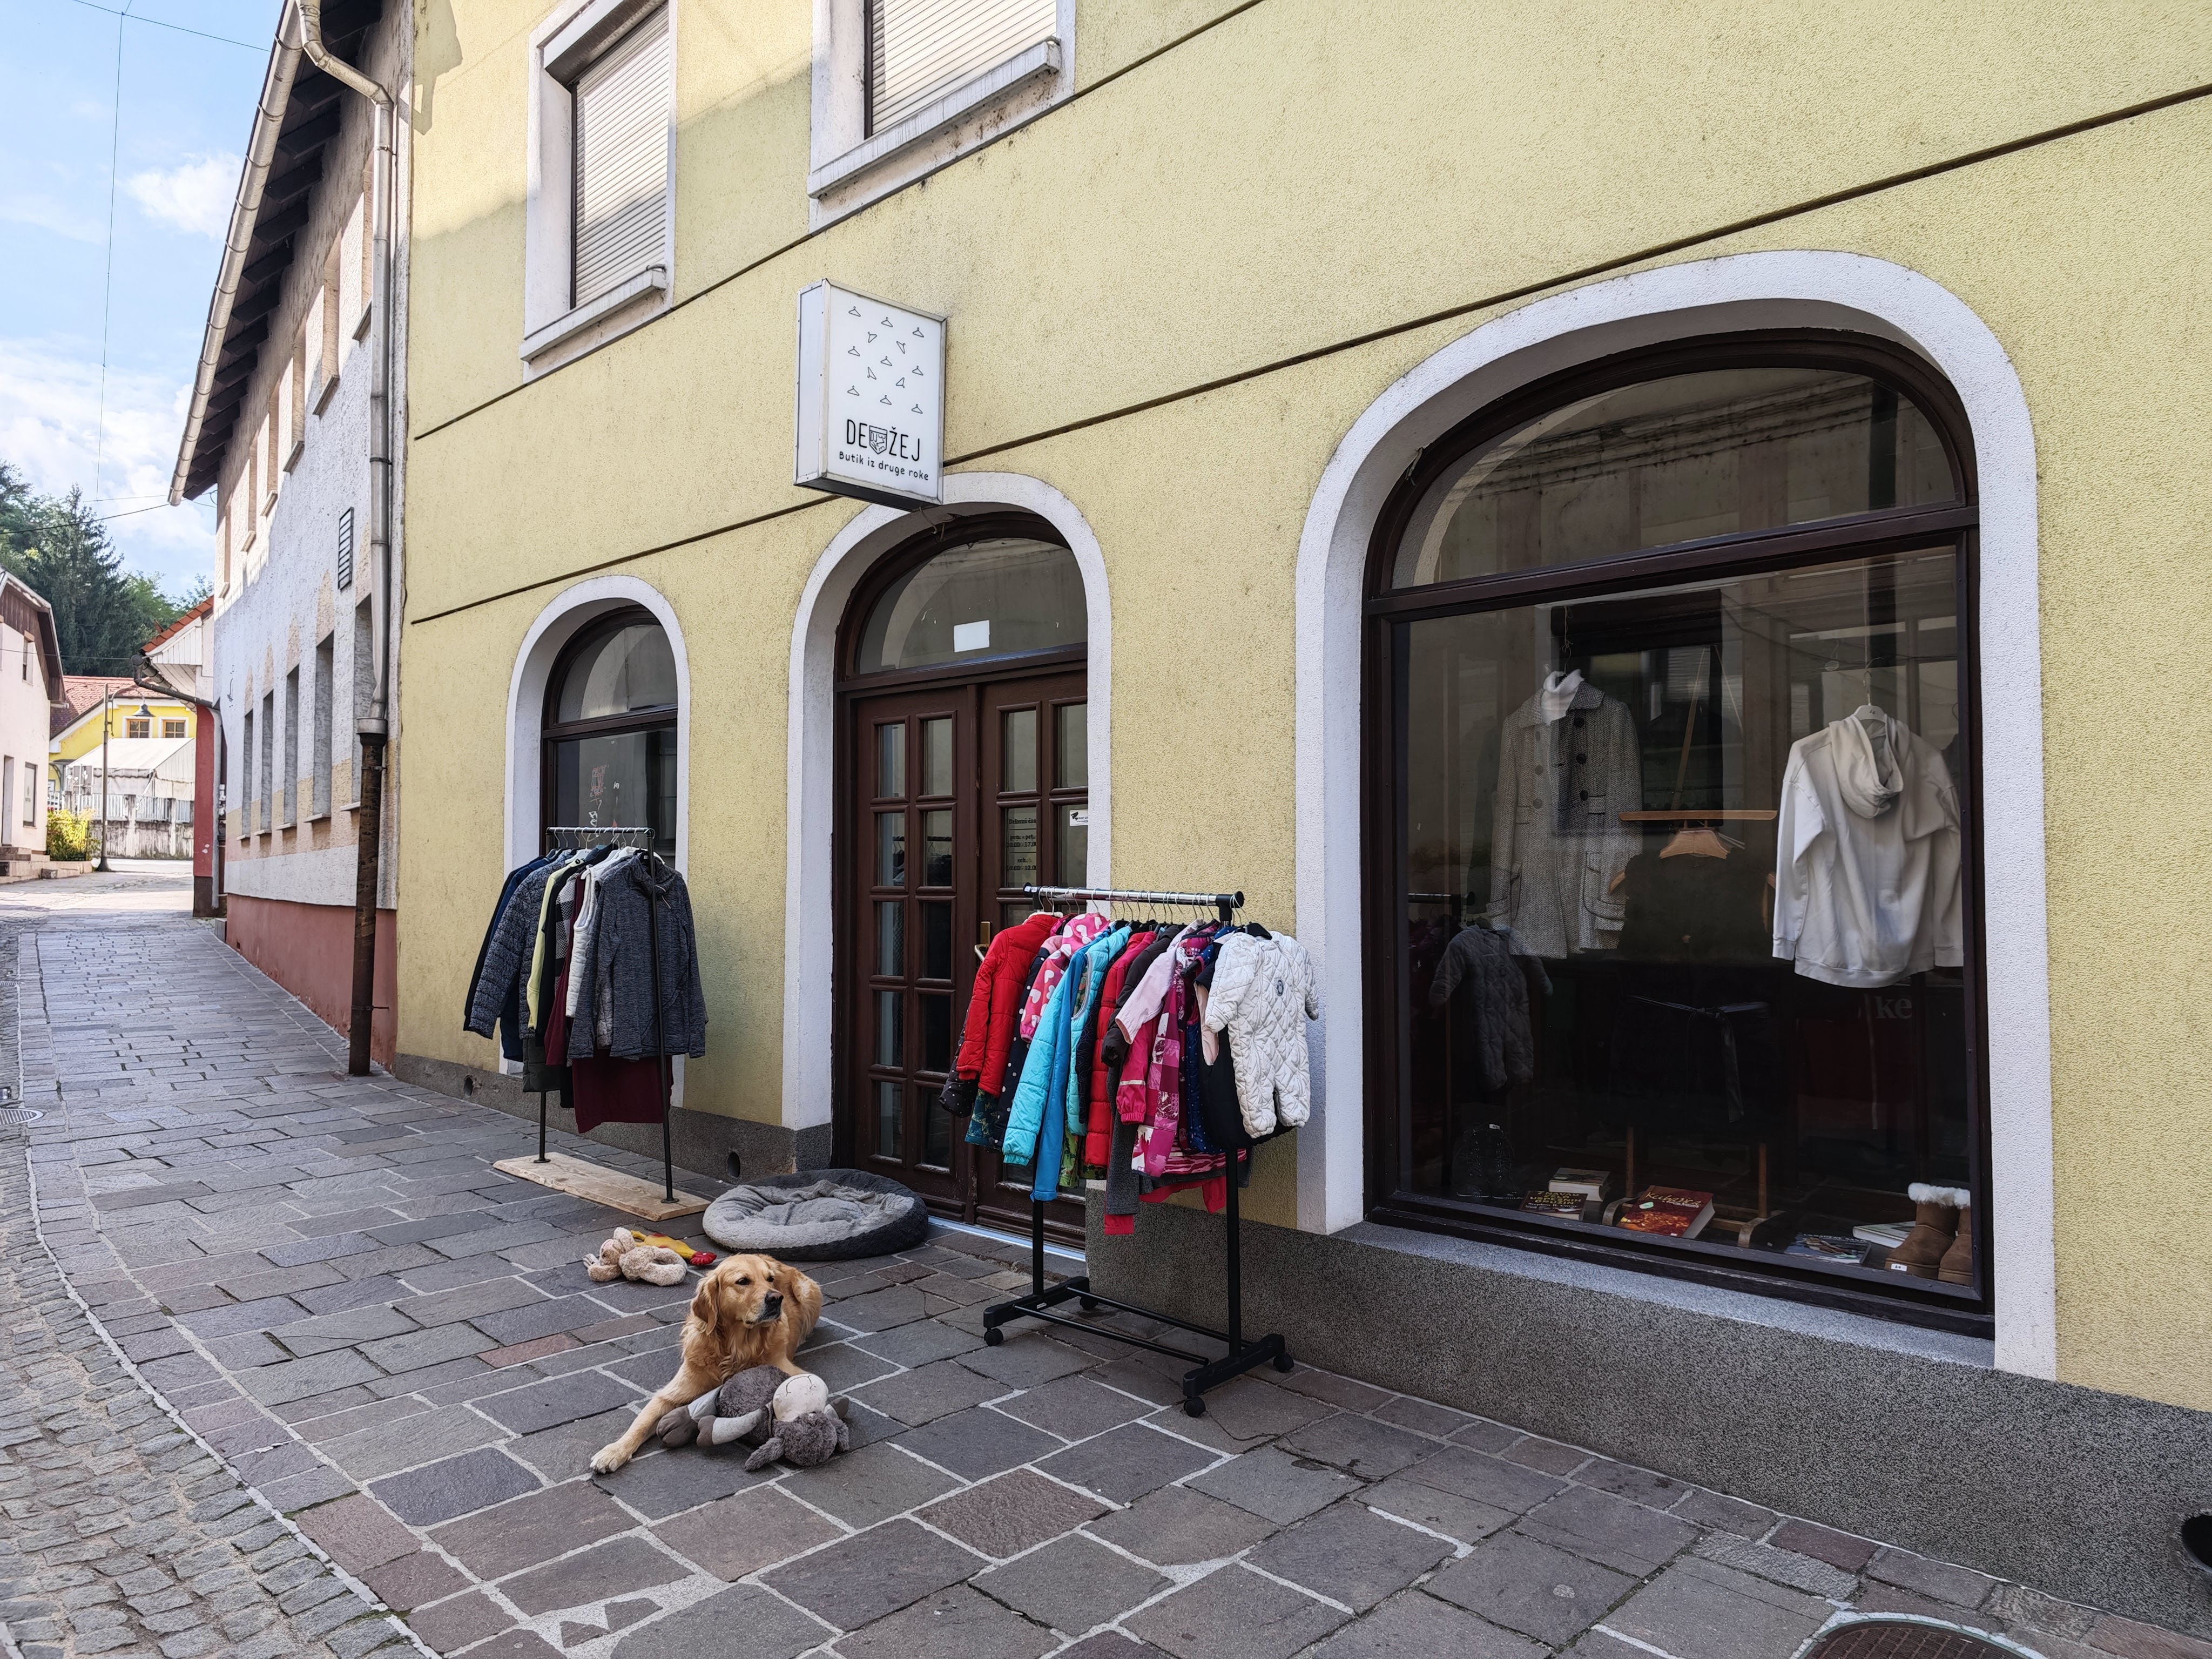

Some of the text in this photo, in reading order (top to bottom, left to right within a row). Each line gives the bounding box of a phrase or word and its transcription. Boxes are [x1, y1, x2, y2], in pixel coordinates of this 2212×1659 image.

[839, 451, 929, 481] Butik iz druge roke
[1645, 1191, 1702, 1206] Kuharica
